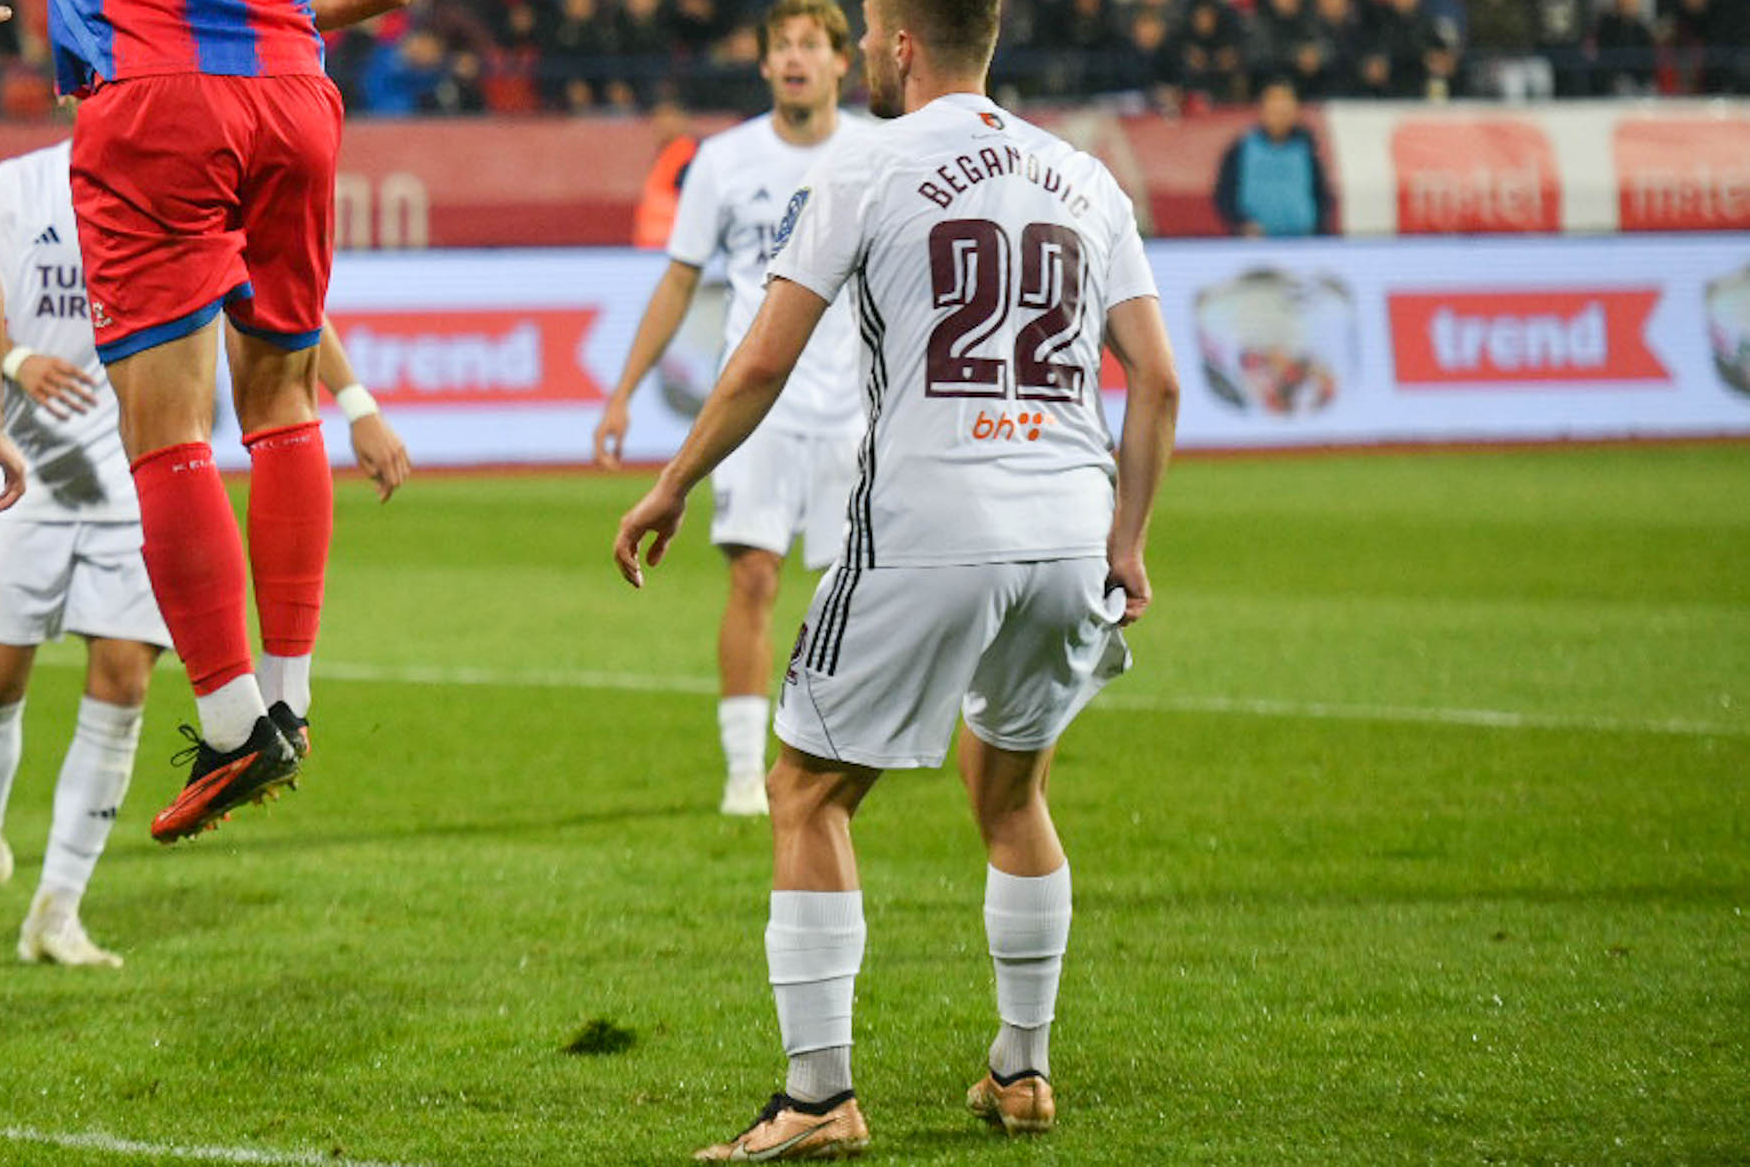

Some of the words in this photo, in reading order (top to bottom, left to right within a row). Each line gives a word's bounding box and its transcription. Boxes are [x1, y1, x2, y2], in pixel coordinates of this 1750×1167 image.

[925, 219, 1088, 404] 22
[1428, 301, 1607, 369] trend
[349, 321, 542, 392] trend
